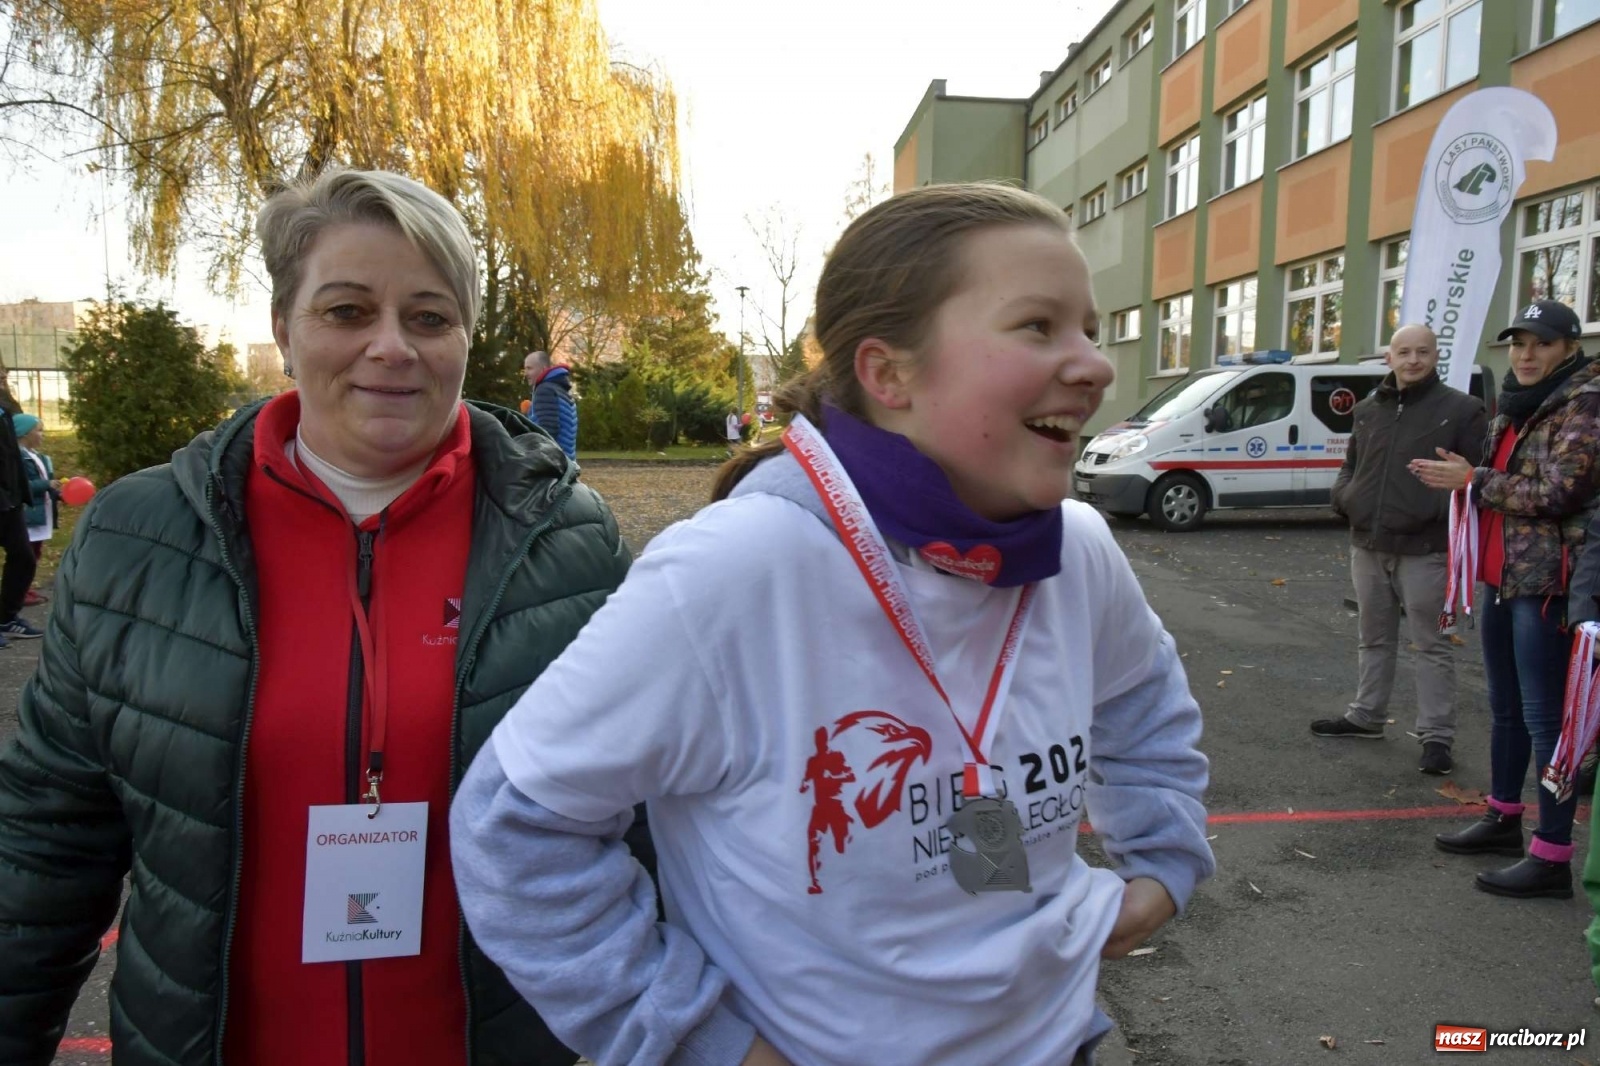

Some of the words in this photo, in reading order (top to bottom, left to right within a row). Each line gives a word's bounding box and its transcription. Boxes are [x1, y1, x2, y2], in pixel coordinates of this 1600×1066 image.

[1443, 139, 1467, 166] LASY
[1524, 304, 1542, 319] LA
[316, 830, 419, 846] ORGANIZATOR
[915, 864, 938, 883] pod
[325, 928, 403, 943] KuźniaKultury
